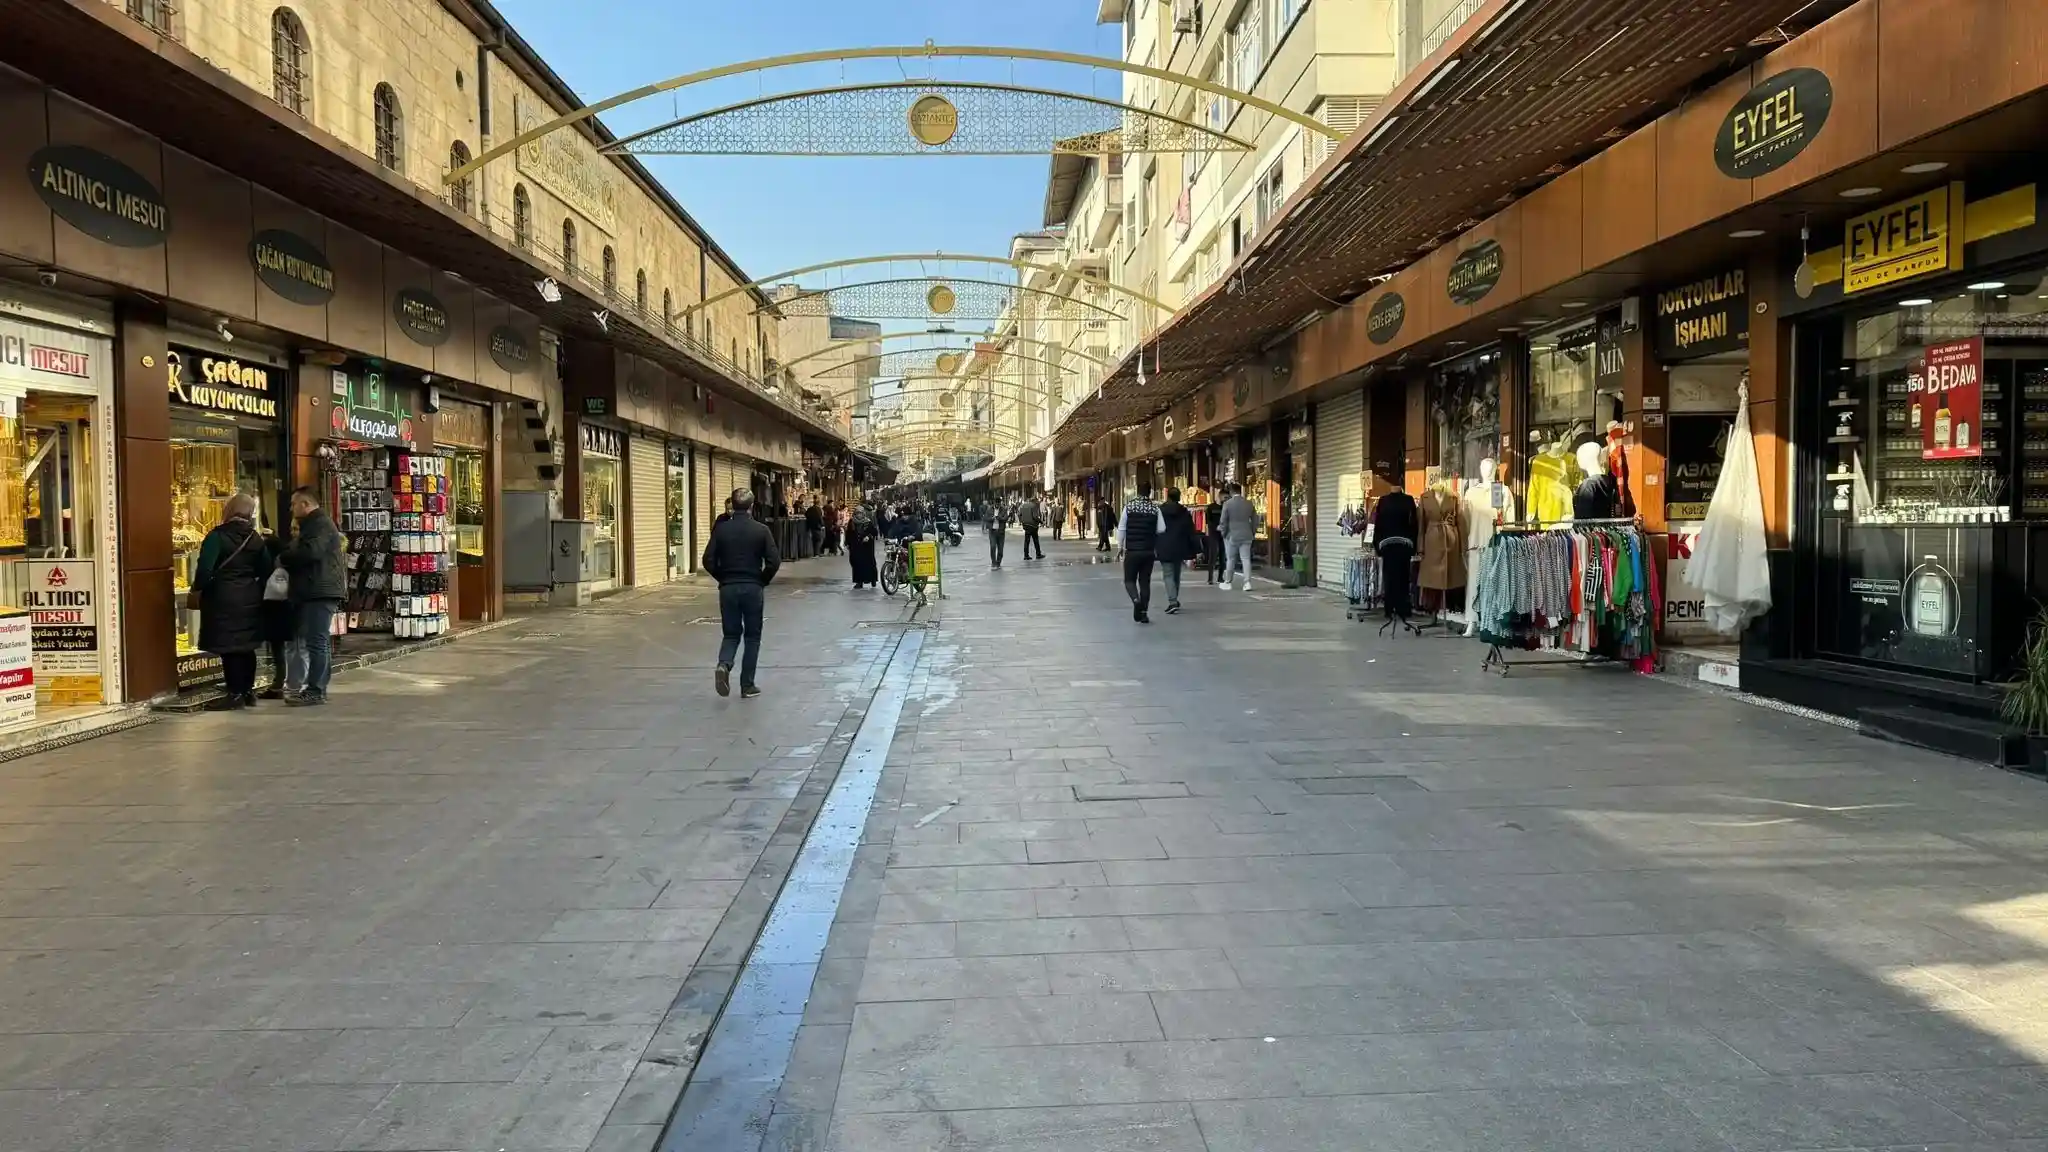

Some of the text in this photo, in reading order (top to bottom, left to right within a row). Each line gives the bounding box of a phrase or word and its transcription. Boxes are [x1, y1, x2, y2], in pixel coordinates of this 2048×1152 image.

[1734, 86, 1804, 150] EYFEL
[42, 162, 166, 231] ALTINCI MESUT
[1852, 201, 1939, 263] EYFEL
[1850, 257, 1939, 286] EAU DE PARFUM
[1657, 269, 1745, 316] DOKTORLAR
[1675, 311, 1727, 349] İŞHANI
[0, 333, 25, 367] CI
[1600, 342, 1625, 377] MİN
[202, 357, 267, 391] ÇAĞAN
[1907, 376, 1924, 393] 150
[1927, 364, 1977, 395] BEDAVA
[191, 385, 276, 417] KUYUMCULUK
[586, 398, 605, 409] WC
[583, 426, 621, 456] ELMAS
[24, 591, 91, 607] ALTINCI
[1921, 600, 1939, 610] EYFEL
[32, 641, 56, 649] aksit
[62, 629, 73, 637] 12
[75, 629, 94, 640] Aya
[177, 657, 208, 676] ÇAĞAN
[6, 692, 32, 703] WORLD
